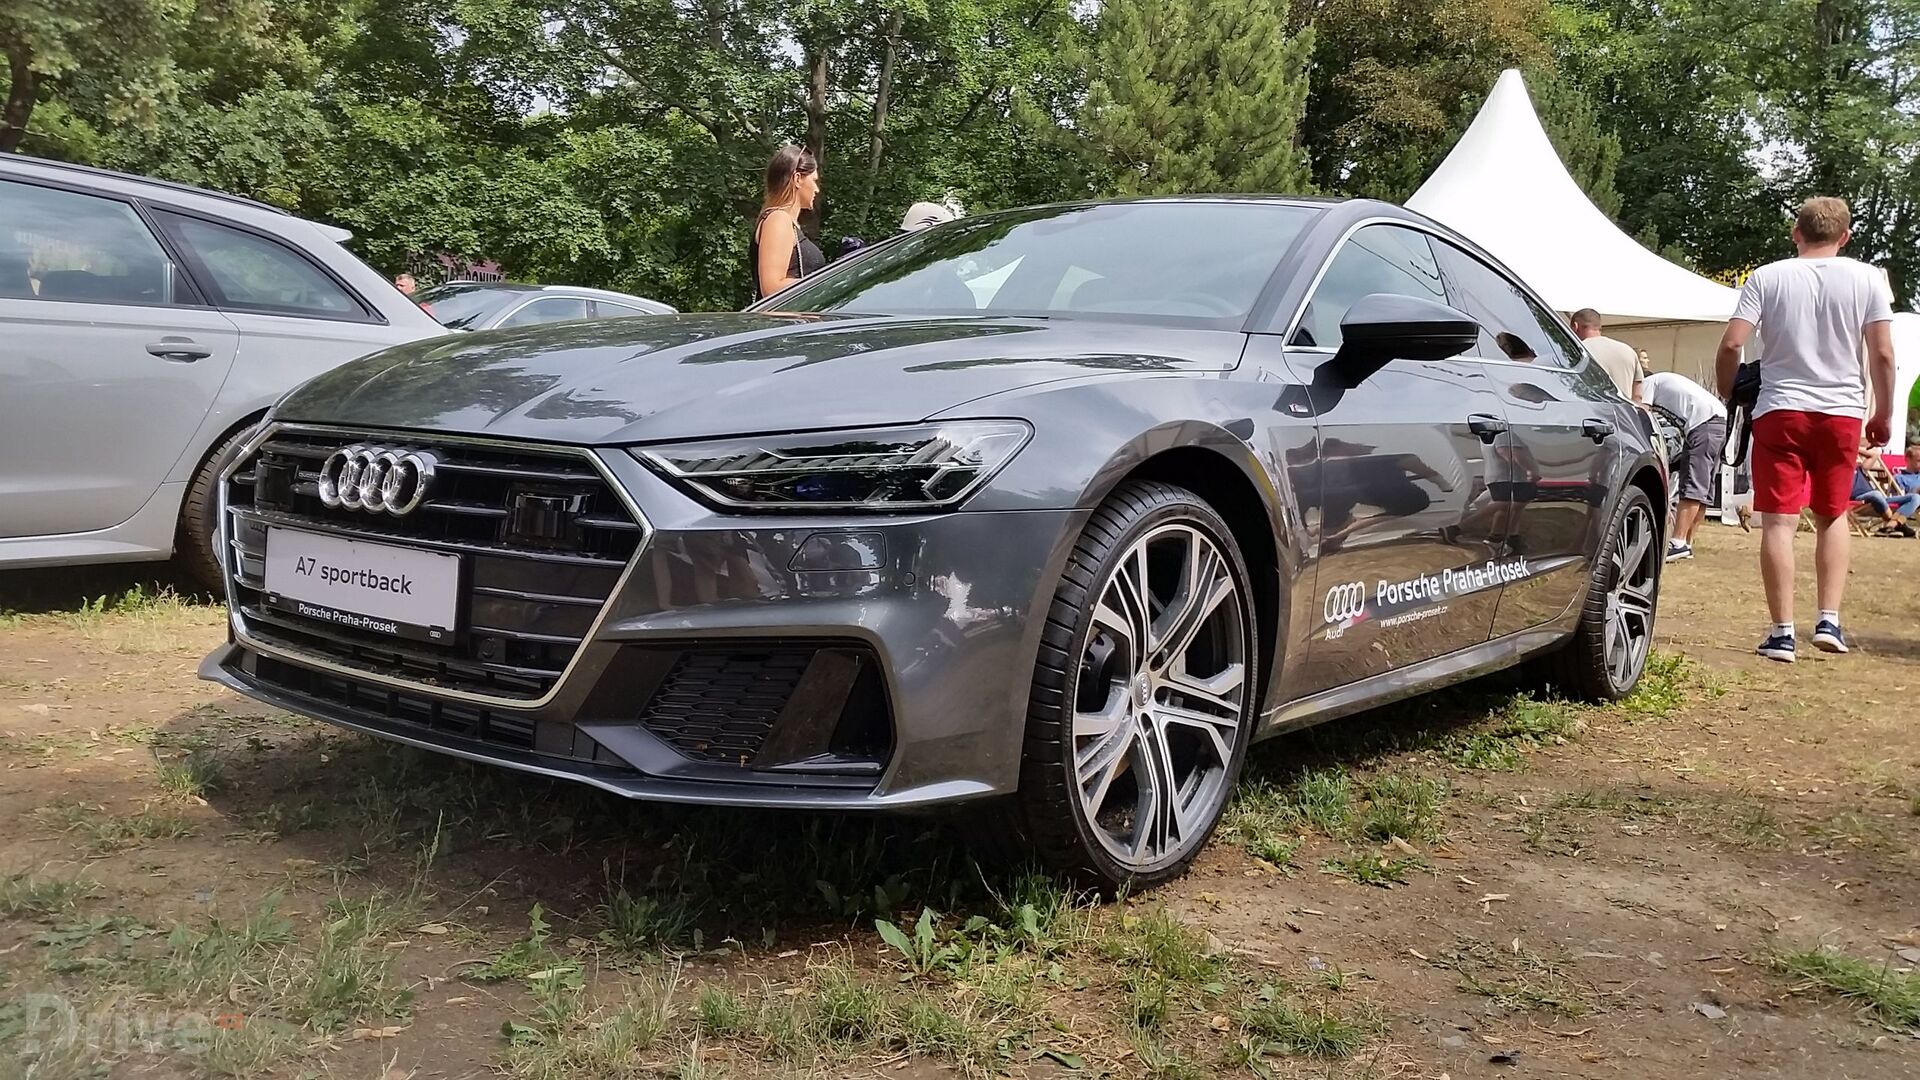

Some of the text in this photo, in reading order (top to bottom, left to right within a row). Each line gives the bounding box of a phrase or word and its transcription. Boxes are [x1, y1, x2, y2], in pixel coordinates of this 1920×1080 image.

[295, 556, 412, 595] A7 sportback
[1376, 555, 1531, 606] Porsche Praha-Prosek
[298, 602, 398, 634] Porsche Praha-Prosek
[1324, 626, 1344, 640] Audi
